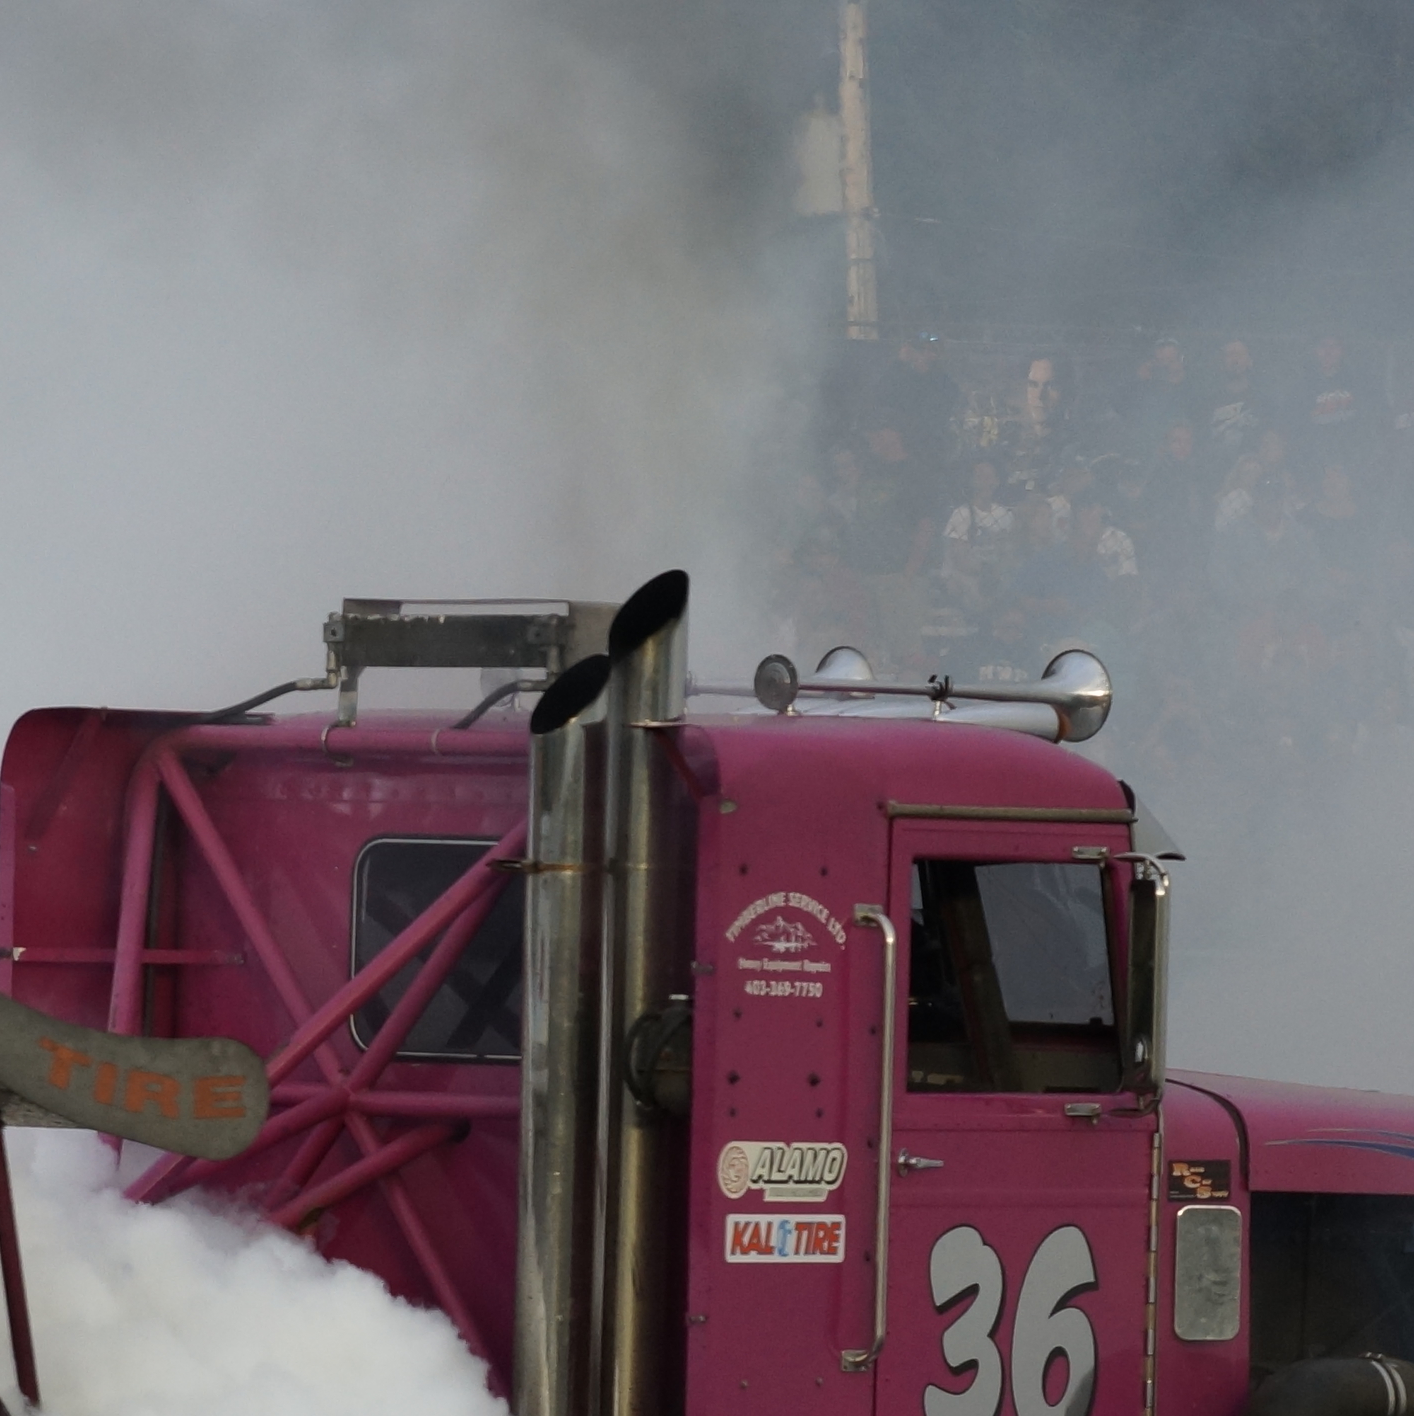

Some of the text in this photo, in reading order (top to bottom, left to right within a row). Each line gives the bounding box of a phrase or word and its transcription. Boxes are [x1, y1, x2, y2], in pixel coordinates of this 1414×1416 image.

[788, 891, 830, 924] SERVICE
[36, 1037, 247, 1121] TIRE
[751, 1147, 844, 1185] ALAMO
[730, 1221, 843, 1256] KAL TIRE
